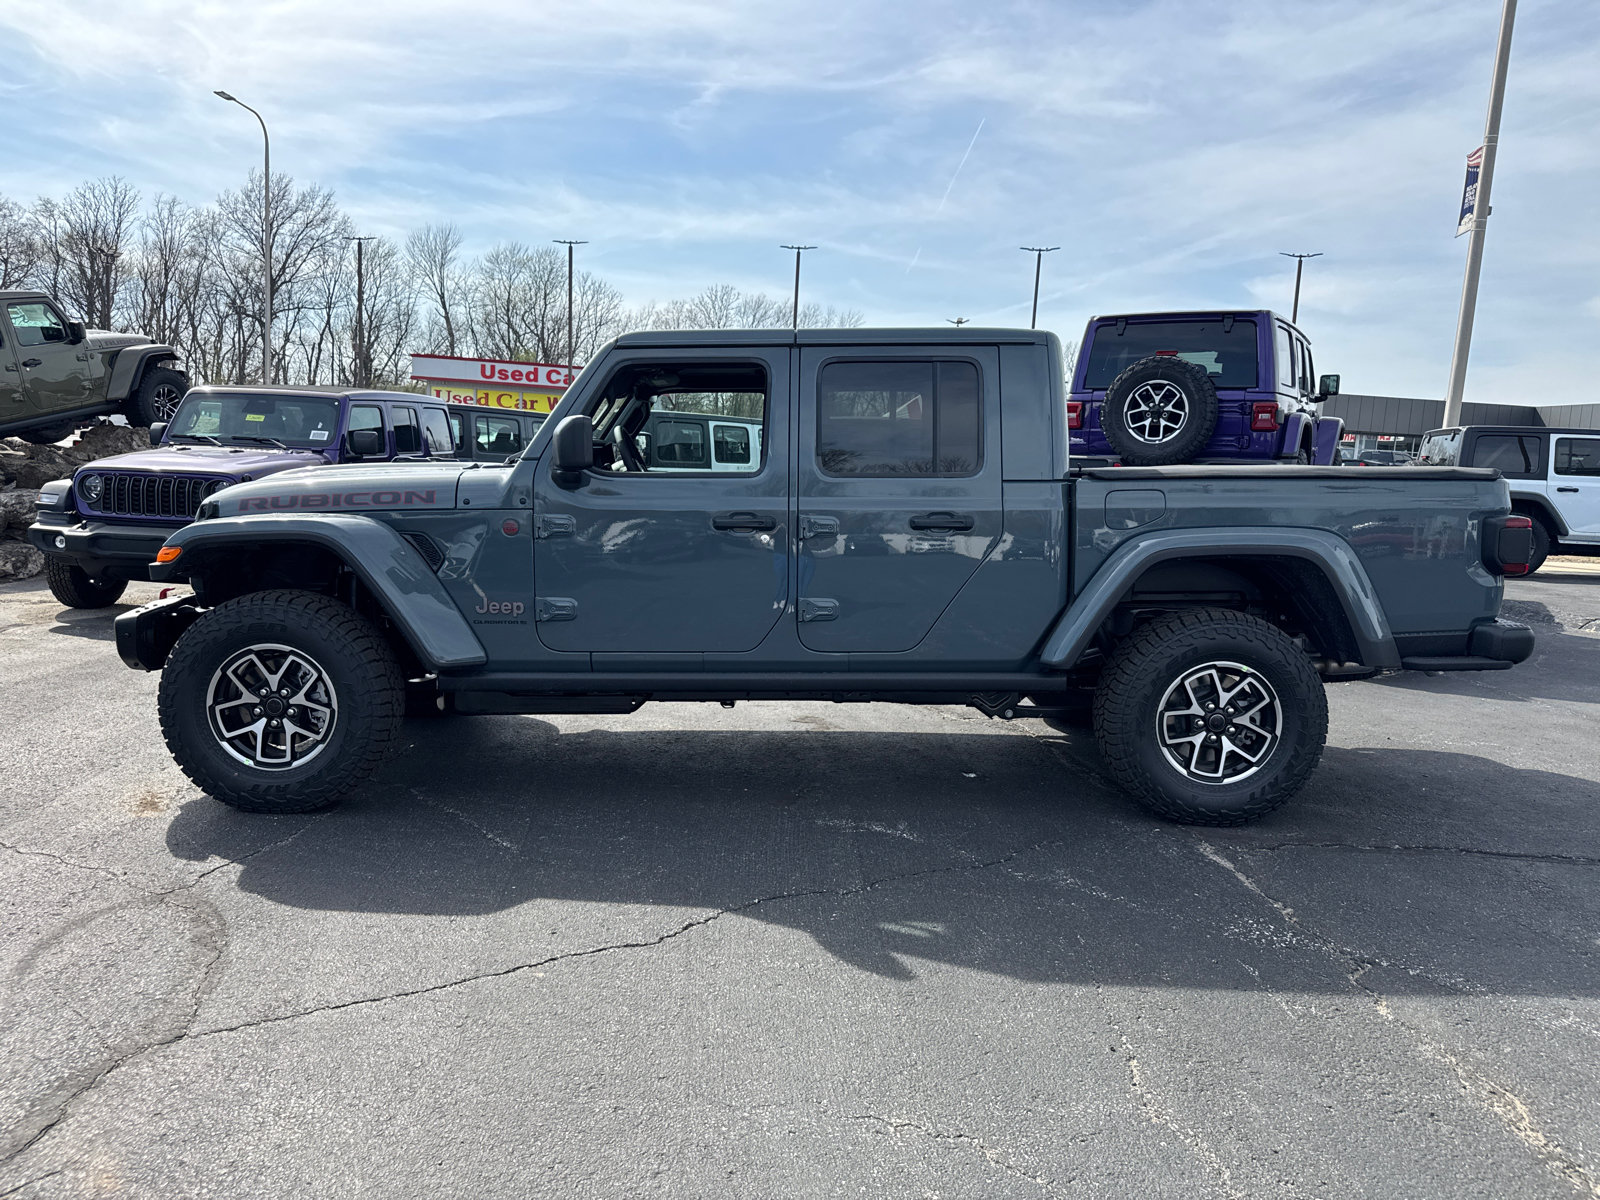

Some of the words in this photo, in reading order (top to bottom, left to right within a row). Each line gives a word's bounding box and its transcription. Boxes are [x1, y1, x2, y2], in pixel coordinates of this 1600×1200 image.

[480, 364, 538, 383] Used
[434, 389, 490, 407] Used
[496, 393, 538, 411] Car
[238, 490, 437, 511] RUBICON
[475, 597, 524, 617] Jeep
